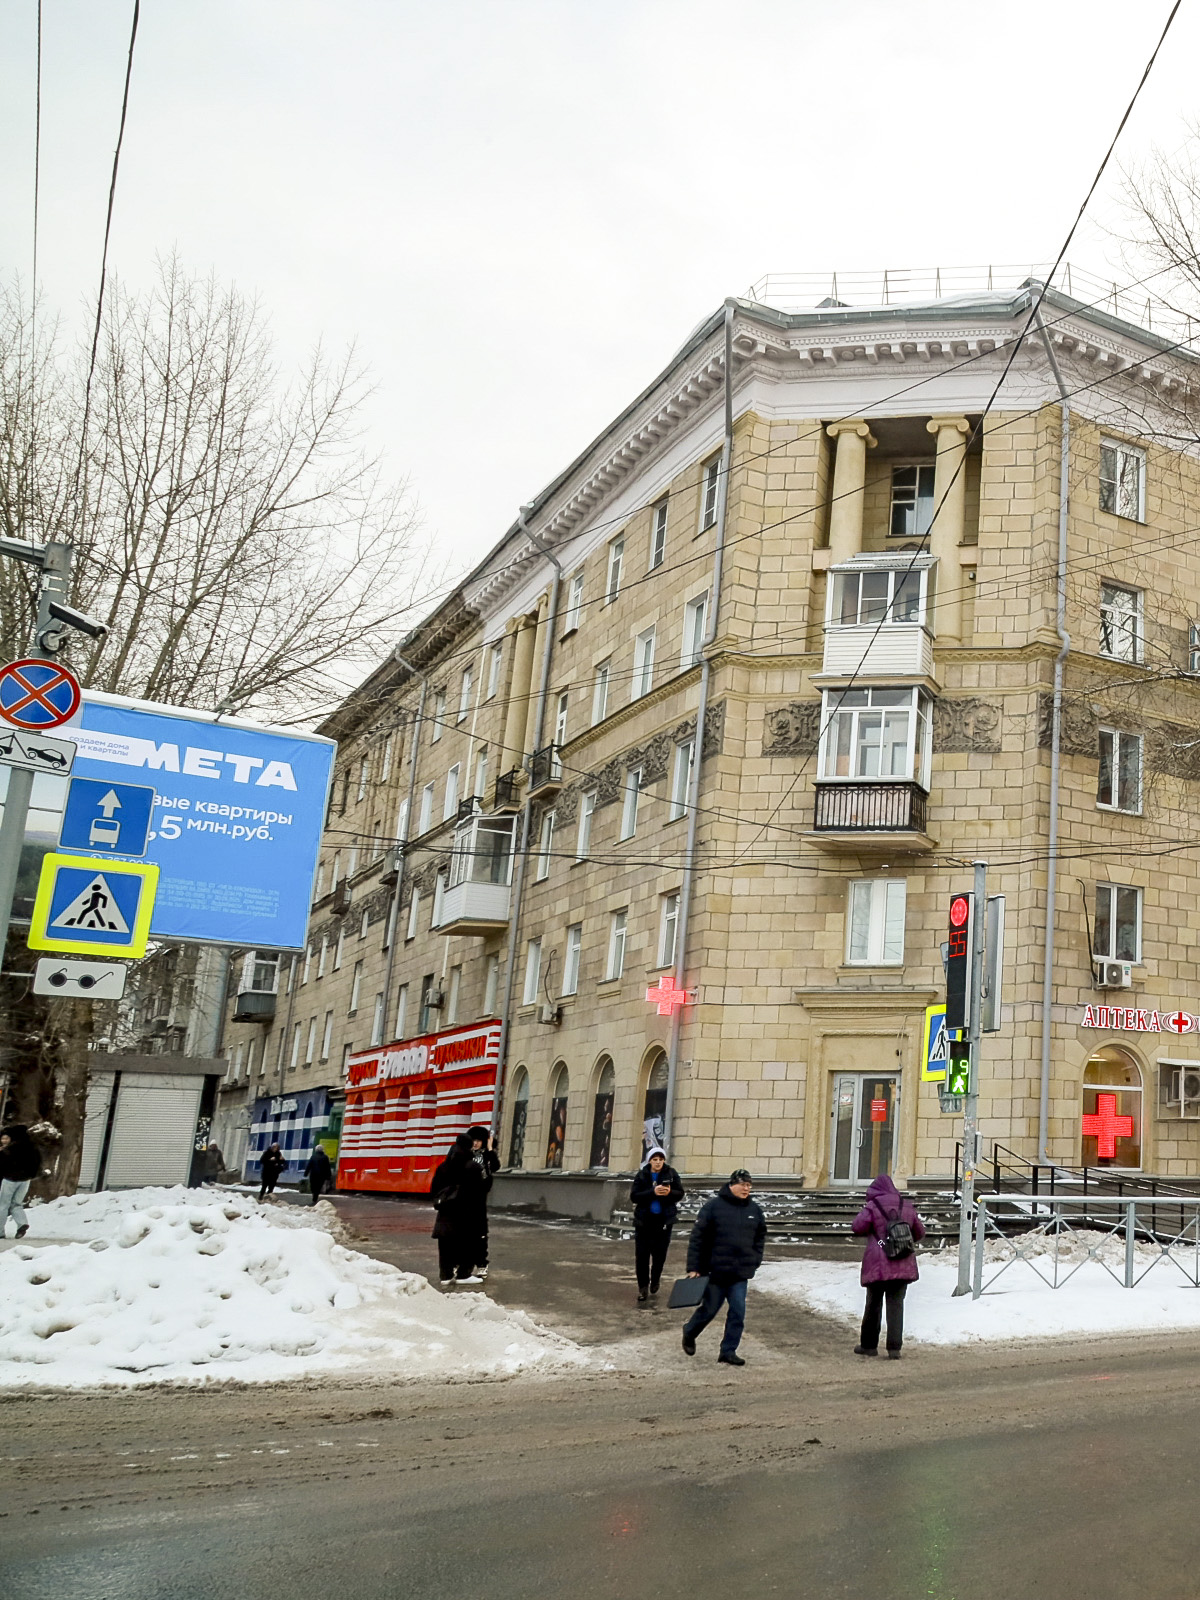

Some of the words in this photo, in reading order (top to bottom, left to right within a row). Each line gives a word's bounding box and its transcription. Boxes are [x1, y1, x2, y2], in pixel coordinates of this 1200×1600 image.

[69, 736, 106, 747] создаем
[107, 742, 130, 751] дома
[88, 746, 129, 757] кварталы
[142, 740, 298, 791] МЕТА
[153, 794, 191, 810] вые
[195, 800, 293, 825] квартиры
[949, 930, 968, 957] 55
[1082, 1005, 1161, 1032] АПТЕКА
[949, 1059, 969, 1076] 19
